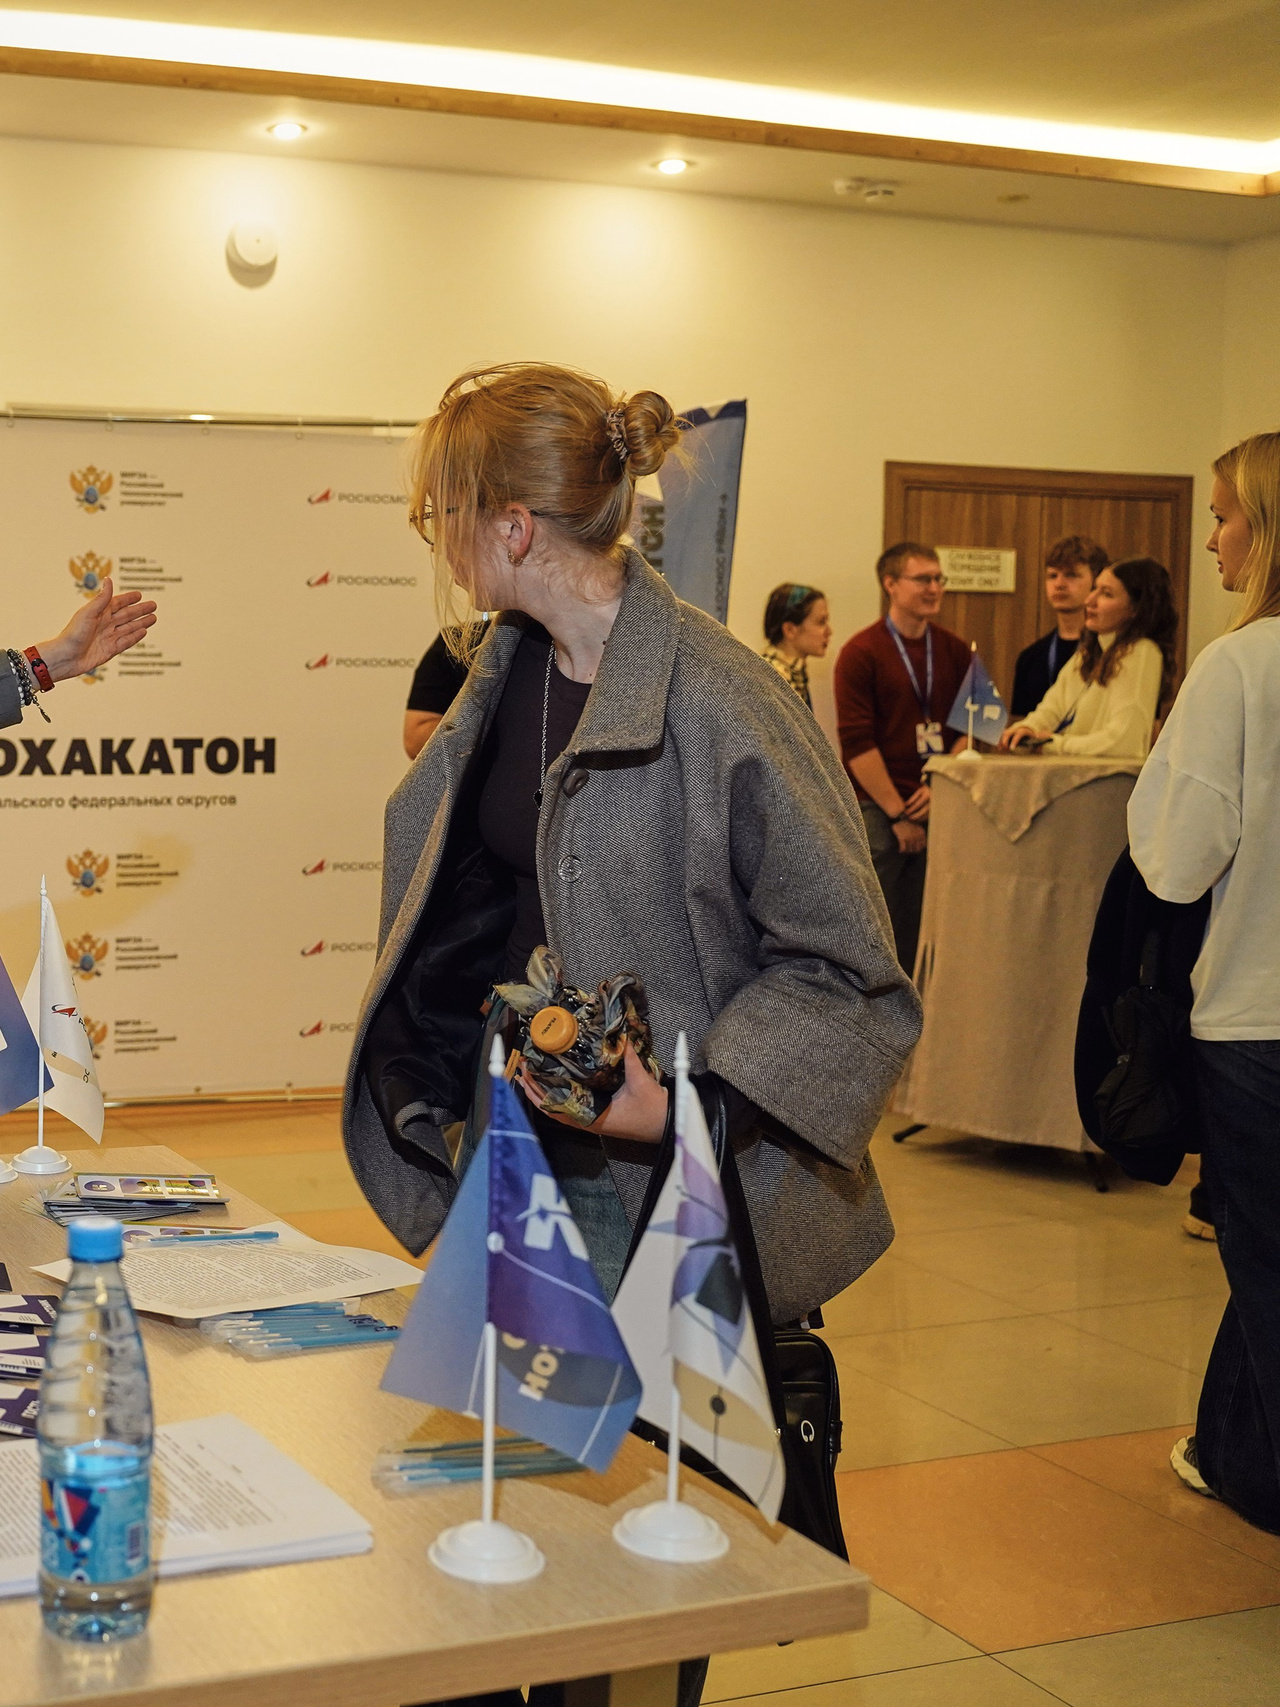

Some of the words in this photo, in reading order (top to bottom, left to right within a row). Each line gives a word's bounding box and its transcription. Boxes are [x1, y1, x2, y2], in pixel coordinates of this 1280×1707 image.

[337, 575, 417, 587] РОСКОСМОС
[70, 794, 172, 811] федеральных
[176, 794, 237, 810] округов
[332, 861, 383, 872] РОСКОС
